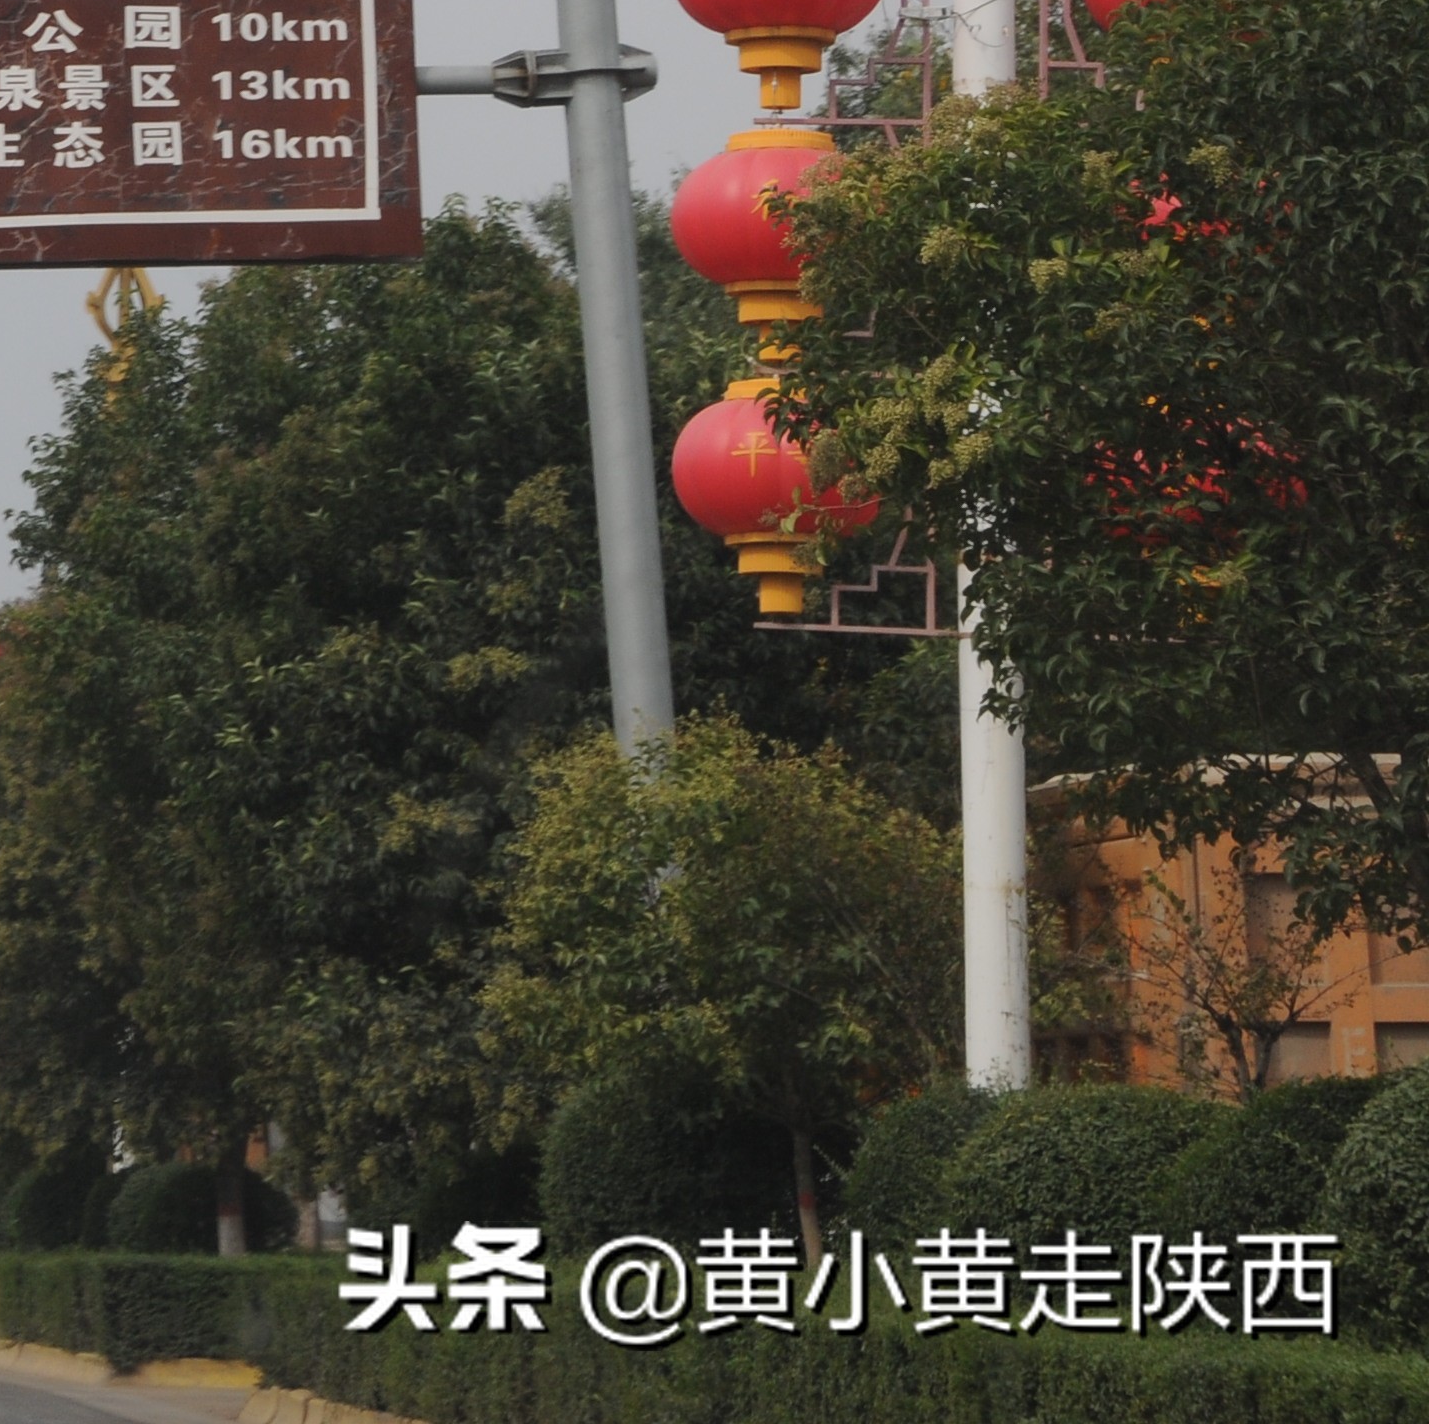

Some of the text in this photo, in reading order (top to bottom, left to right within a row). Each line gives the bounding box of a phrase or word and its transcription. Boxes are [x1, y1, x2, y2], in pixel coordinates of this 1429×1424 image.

[212, 12, 348, 42] 10km
[212, 69, 350, 100] 13km
[213, 128, 353, 159] 16km
